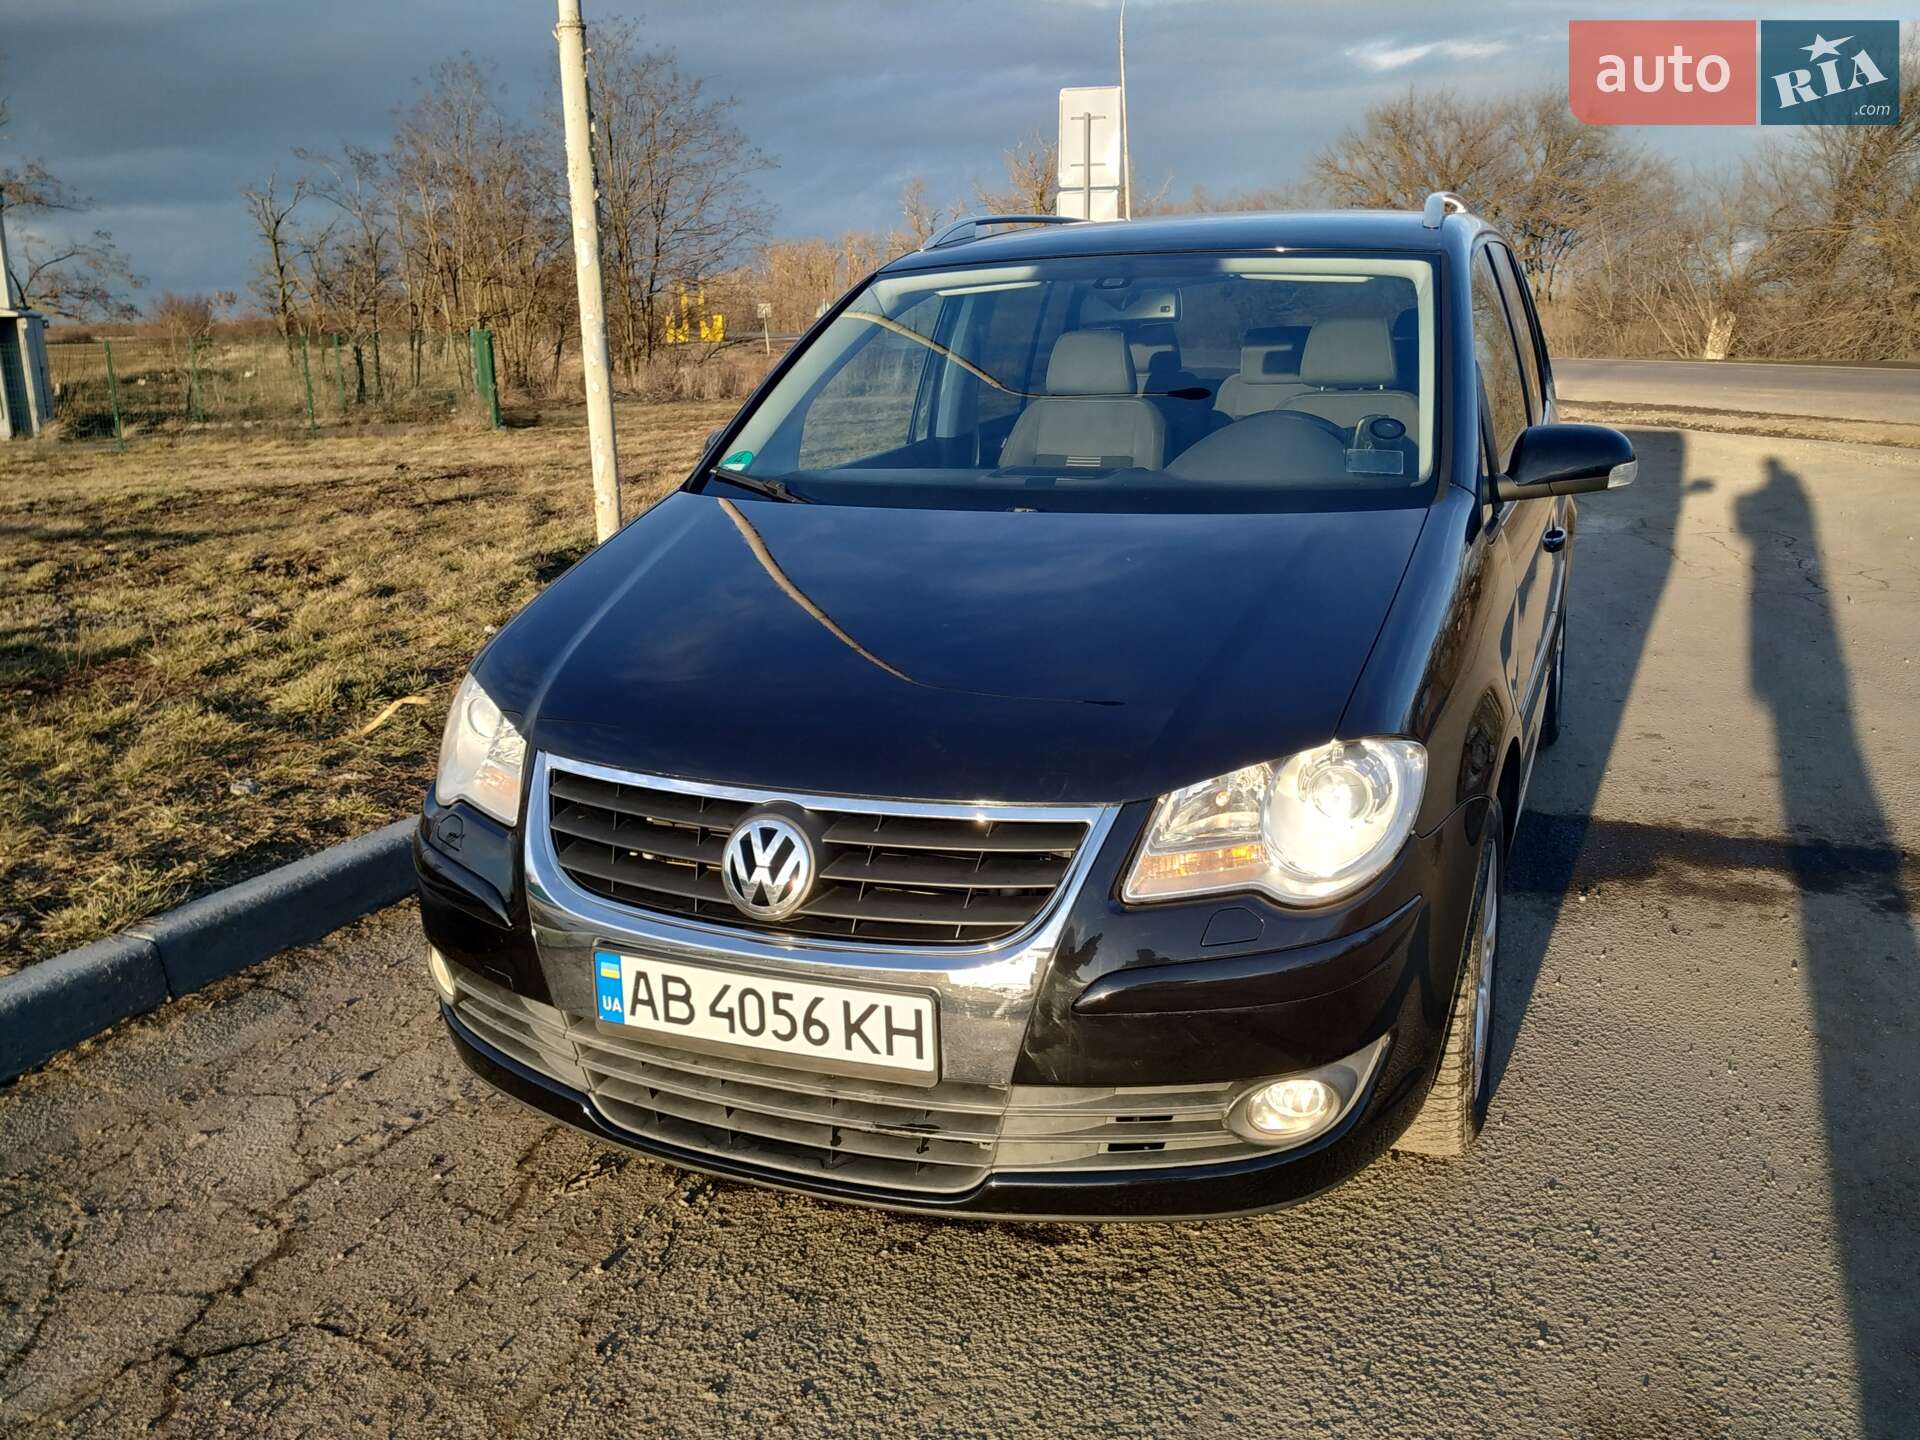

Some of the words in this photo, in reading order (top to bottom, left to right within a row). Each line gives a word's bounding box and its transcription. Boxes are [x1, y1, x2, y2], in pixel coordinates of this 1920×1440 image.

[602, 995, 622, 1013] UA
[629, 970, 696, 1026] AB
[708, 983, 830, 1047] 4056
[843, 1000, 924, 1060] KH
